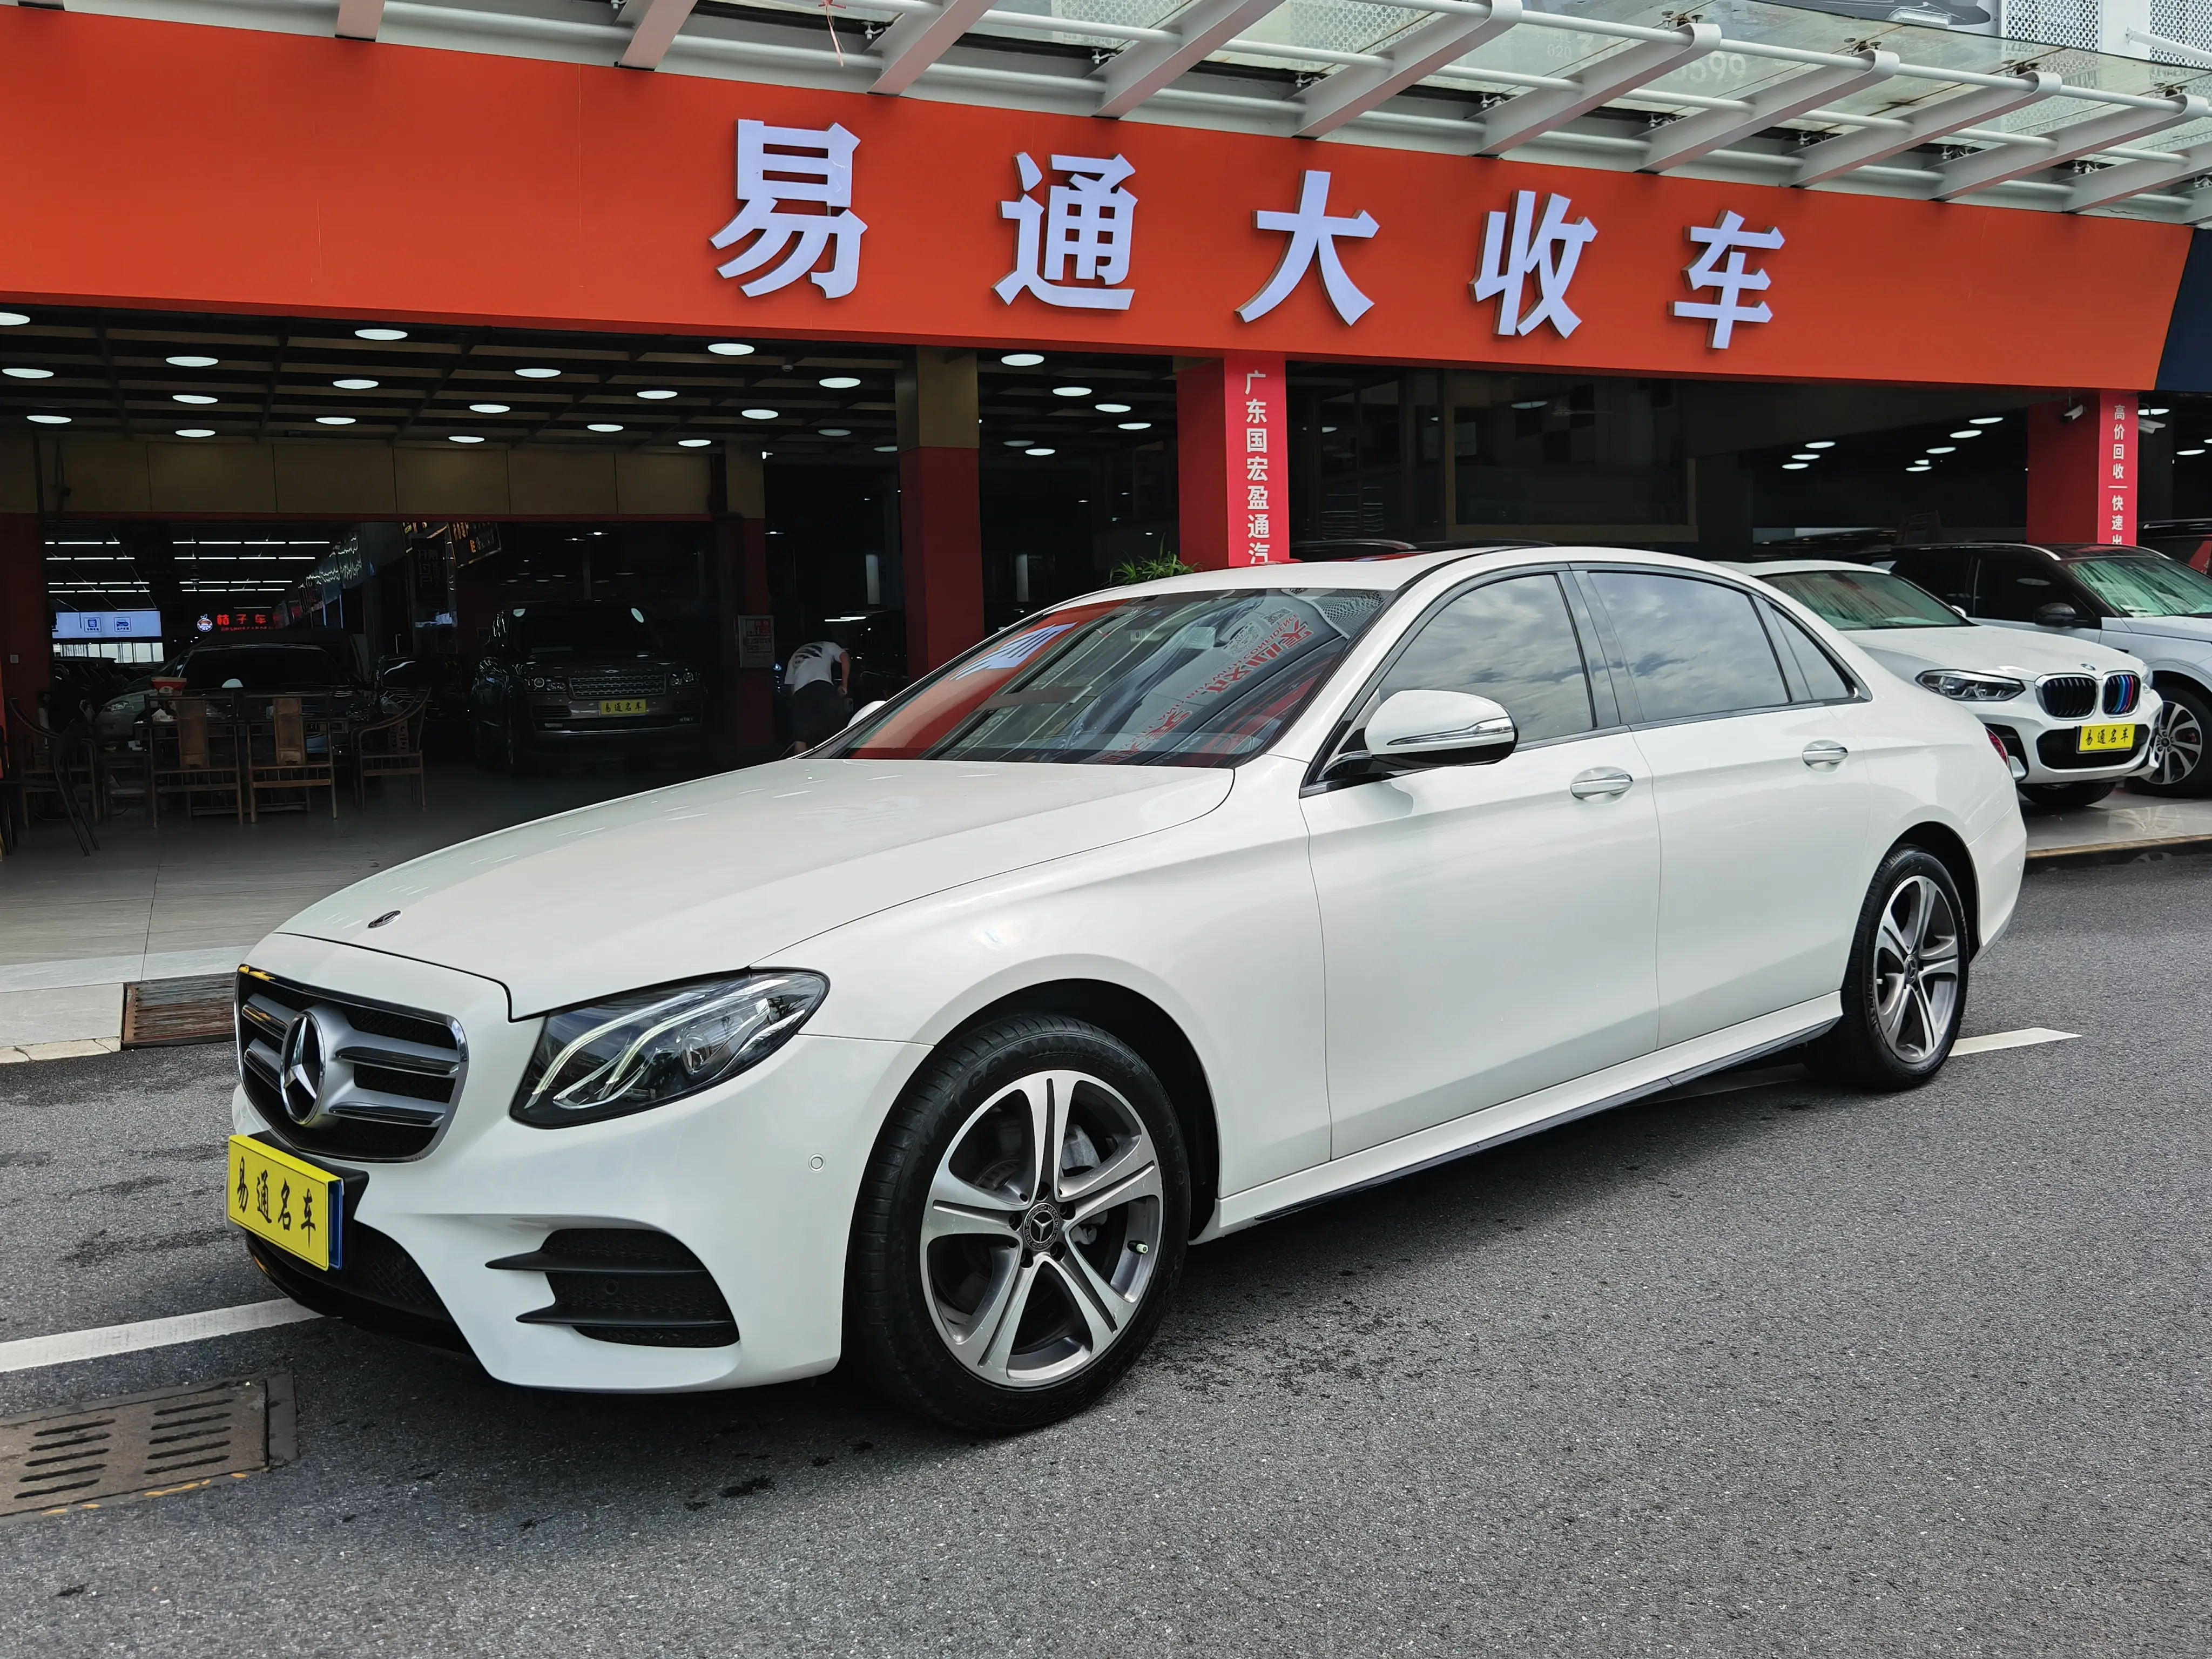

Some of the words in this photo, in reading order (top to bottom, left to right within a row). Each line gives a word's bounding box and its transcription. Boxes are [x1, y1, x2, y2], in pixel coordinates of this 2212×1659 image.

[710, 117, 1789, 350] 易通大收车
[1244, 369, 1270, 565] 广东国宏盈通汽
[2112, 404, 2126, 480] 高价回收
[2084, 727, 2129, 745] 易通名车
[236, 1156, 317, 1248] 易通名车
